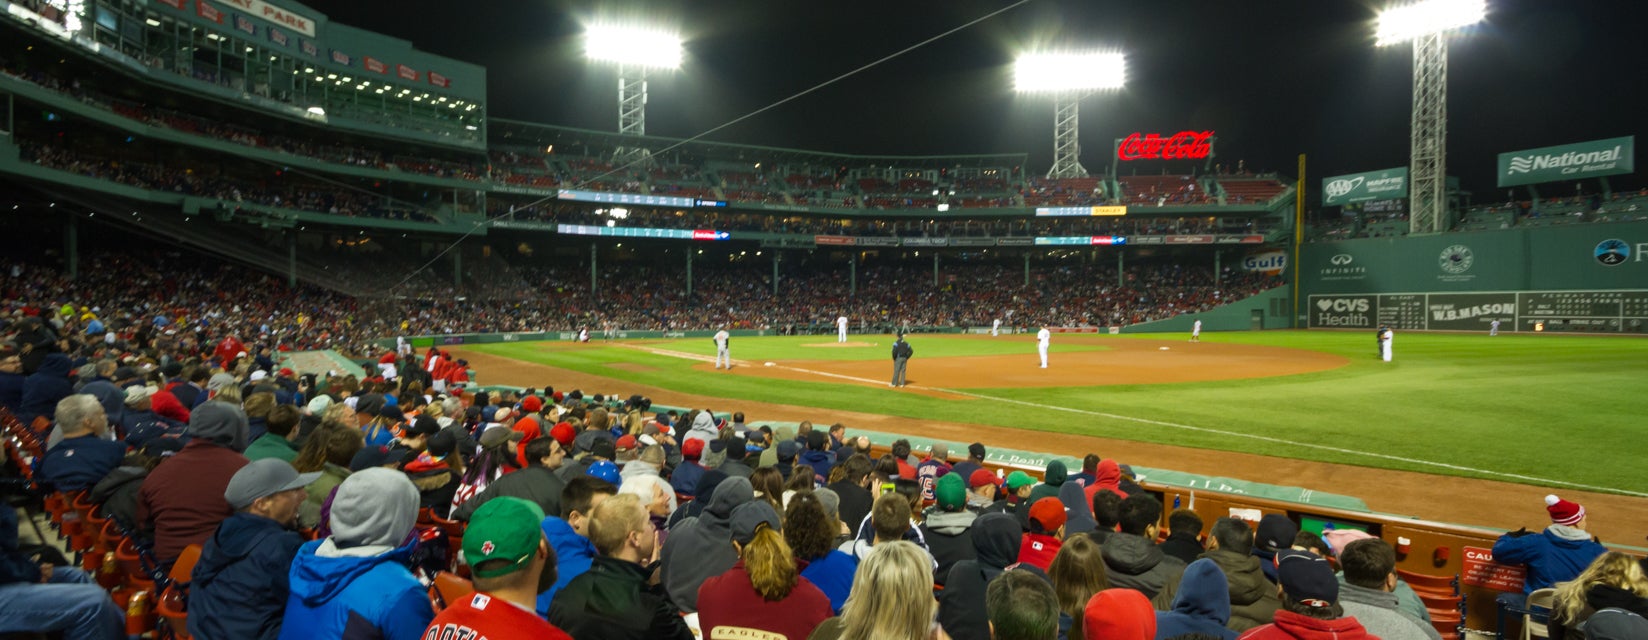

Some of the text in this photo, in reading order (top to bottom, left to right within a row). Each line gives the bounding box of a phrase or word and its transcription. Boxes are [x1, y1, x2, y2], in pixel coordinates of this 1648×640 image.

[263, 6, 307, 31] PARK
[1117, 130, 1216, 161] Coca-Cola
[1532, 145, 1621, 171] National
[1581, 162, 1616, 173] Rental
[1245, 256, 1285, 269] Gulf
[1333, 299, 1370, 312] CVS
[1319, 313, 1369, 326] Health
